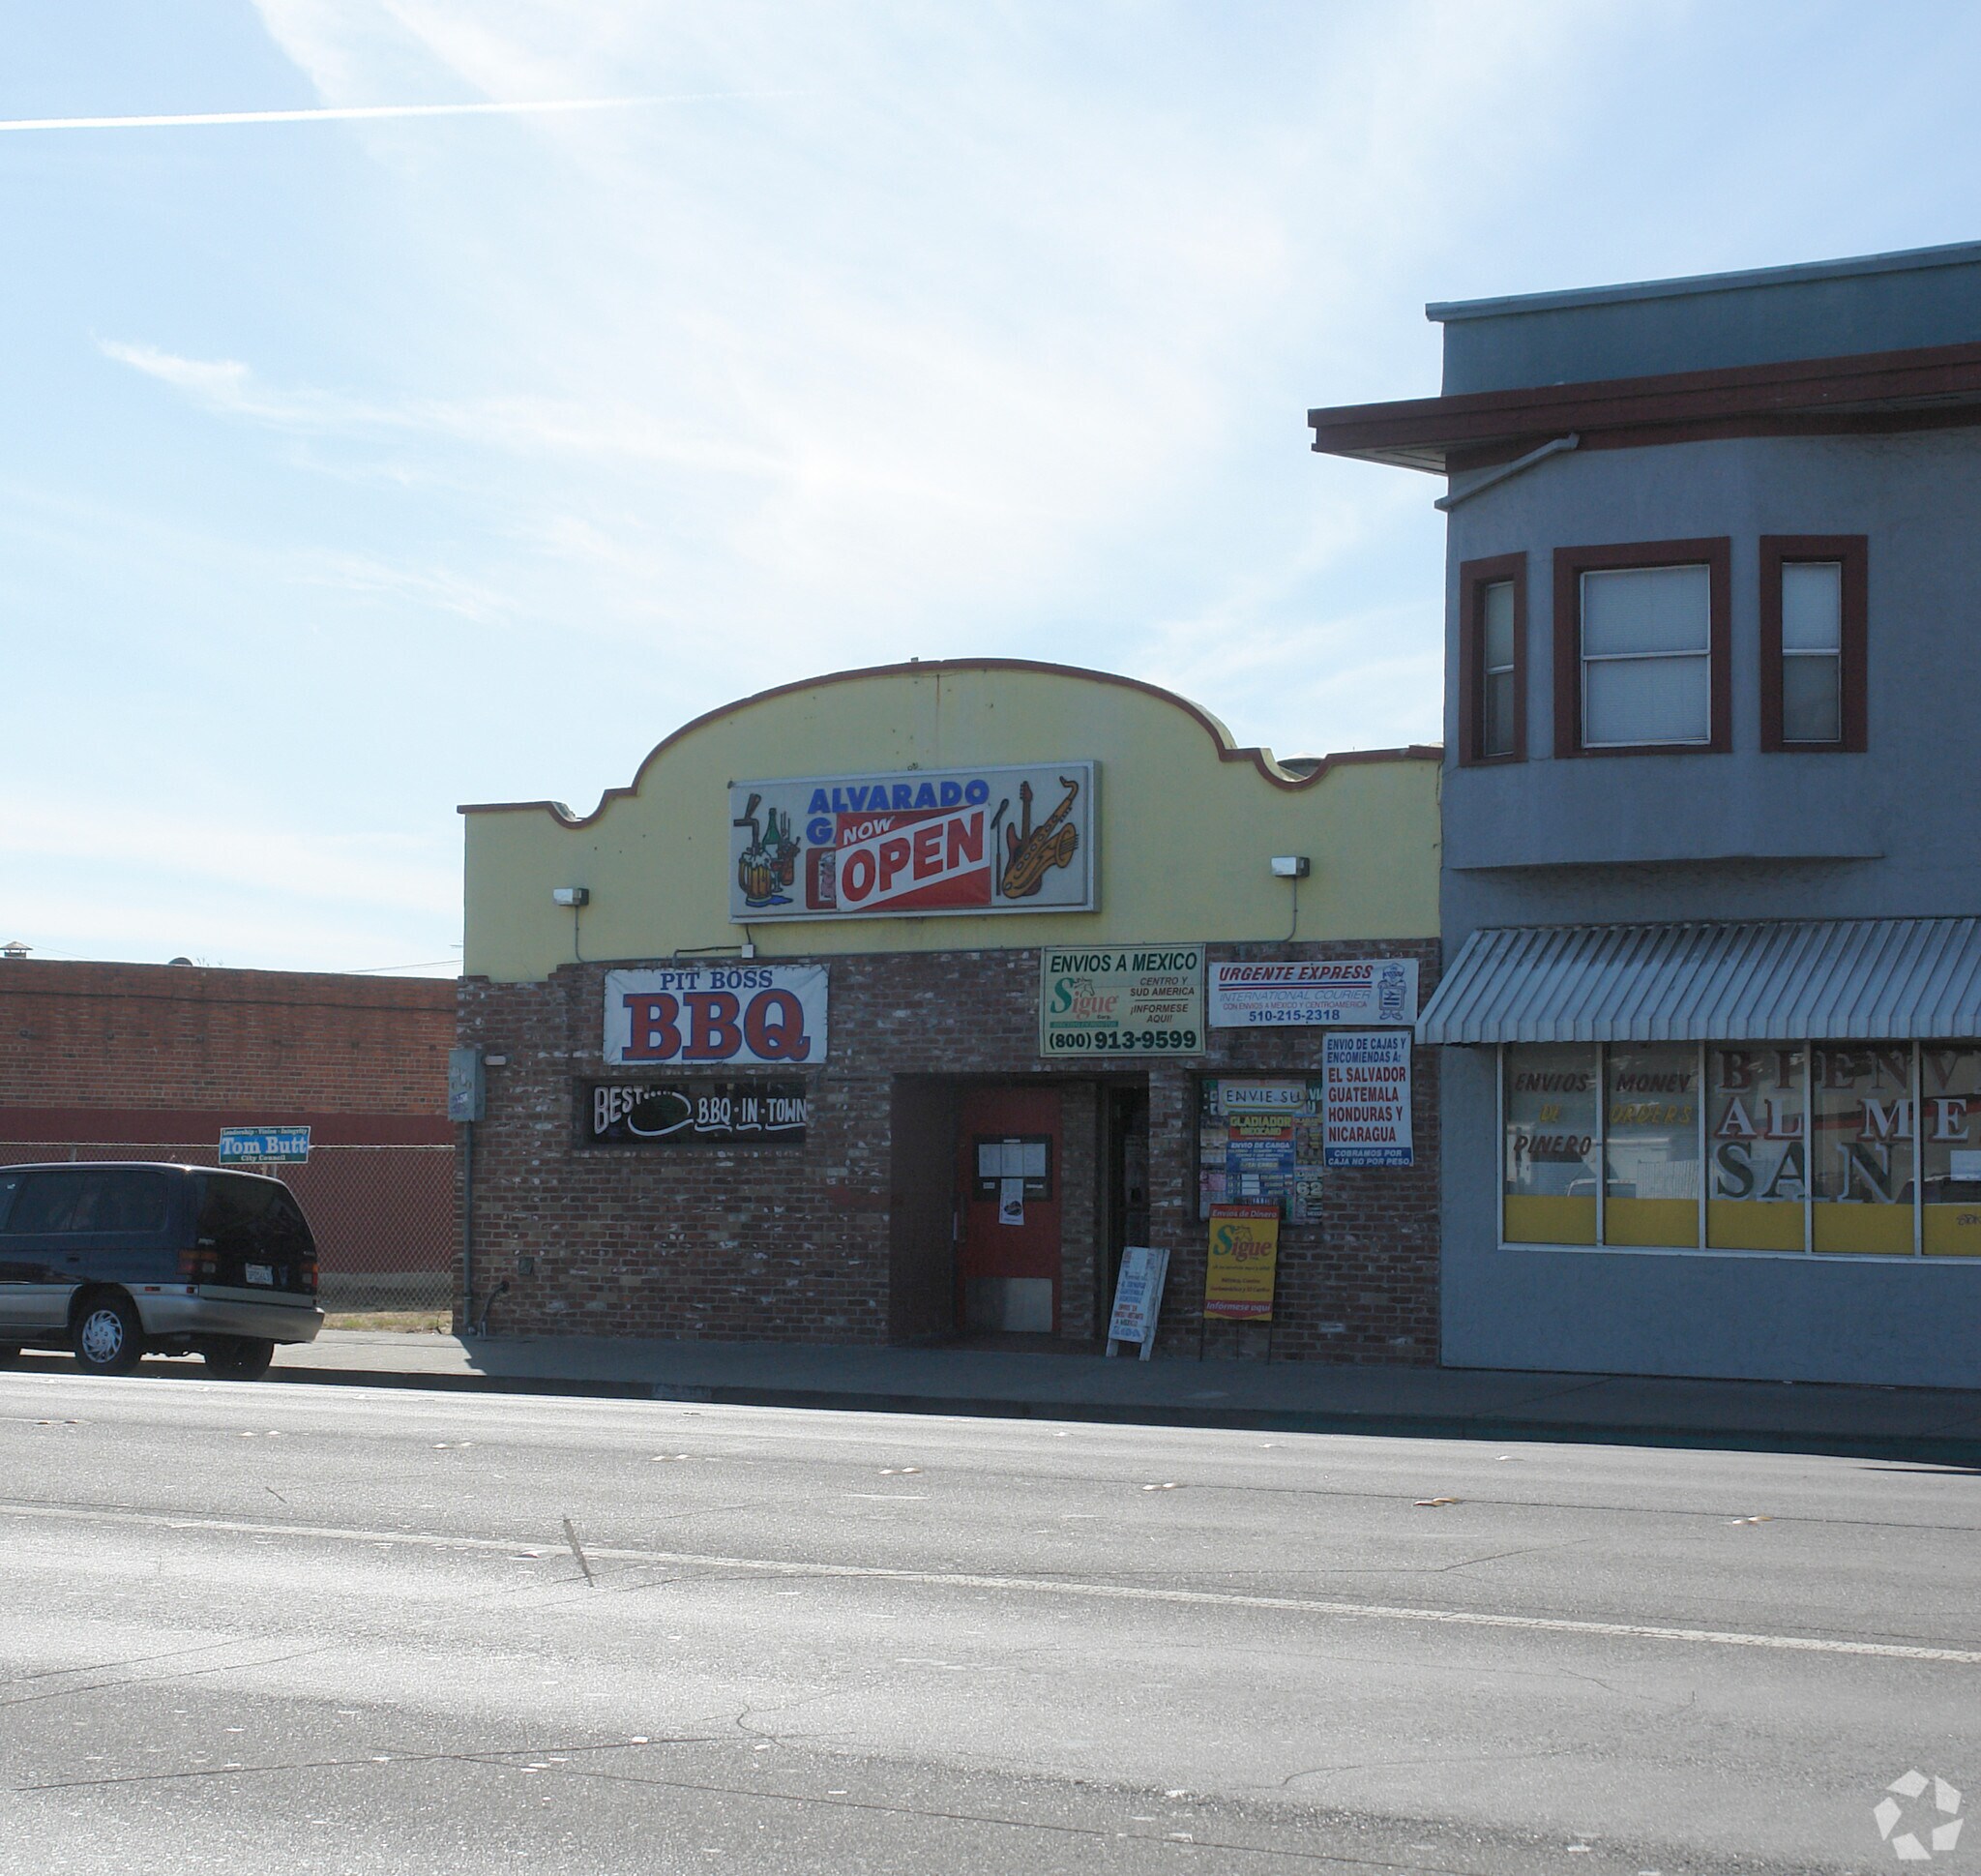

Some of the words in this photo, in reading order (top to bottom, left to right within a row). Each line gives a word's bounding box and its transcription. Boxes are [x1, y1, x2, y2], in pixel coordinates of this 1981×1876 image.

[807, 779, 990, 814] ALVARADO
[843, 815, 896, 844] NOW
[841, 810, 985, 903] OPEN
[1050, 954, 1111, 972] ENVIOS
[1115, 954, 1127, 971] A
[1133, 952, 1197, 971] MEXICO
[660, 971, 700, 990] PIT
[710, 969, 773, 989] BOSS
[1181, 976, 1188, 985] Y
[1219, 967, 1295, 981] URGENTE
[1298, 965, 1374, 980] EXPRESS
[1050, 977, 1117, 1020] Sigue
[1130, 988, 1149, 997] SUD
[1152, 987, 1195, 996] AMERICA
[1220, 991, 1311, 1002] INTERNATIONAL
[1315, 990, 1372, 1000] COURIER
[622, 988, 811, 1061] BBQ
[1249, 1009, 1340, 1022] 510-215-2318
[1050, 1032, 1091, 1050] (800)
[1095, 1030, 1197, 1050] 913-9599
[1327, 1038, 1354, 1050] ENVIO
[1356, 1038, 1368, 1050] DE
[1370, 1037, 1399, 1050] CAJAS
[1400, 1037, 1406, 1049] Y
[1327, 1051, 1390, 1063] ENCOMIENDAS
[1328, 1067, 1343, 1083] EL
[1345, 1066, 1406, 1083] SALVADOR
[1515, 1072, 1588, 1092] ENVIOS
[1616, 1073, 1692, 1092] MONEY
[1227, 1089, 1272, 1103] ENVIE
[1281, 1090, 1300, 1103] SU
[1328, 1087, 1399, 1102] GUATEMALA
[696, 1097, 731, 1125] BBQ
[742, 1098, 757, 1122] IN
[767, 1097, 807, 1122] TOWN
[1328, 1107, 1393, 1122] HONDURAS
[1396, 1106, 1403, 1120] Y
[1610, 1104, 1692, 1123] ORDERS
[1713, 1096, 1805, 1140] AL
[1230, 1116, 1292, 1128] GLADIADOR
[1328, 1126, 1397, 1142] NICARAGUA
[222, 1137, 261, 1154] Tom
[265, 1136, 307, 1153] Butt
[1335, 1148, 1382, 1157] COBRAMOS
[1384, 1148, 1403, 1157] POR
[1713, 1141, 1900, 1204] SAN
[1250, 1209, 1277, 1218] Dinero
[1213, 1224, 1272, 1262] Sigue
